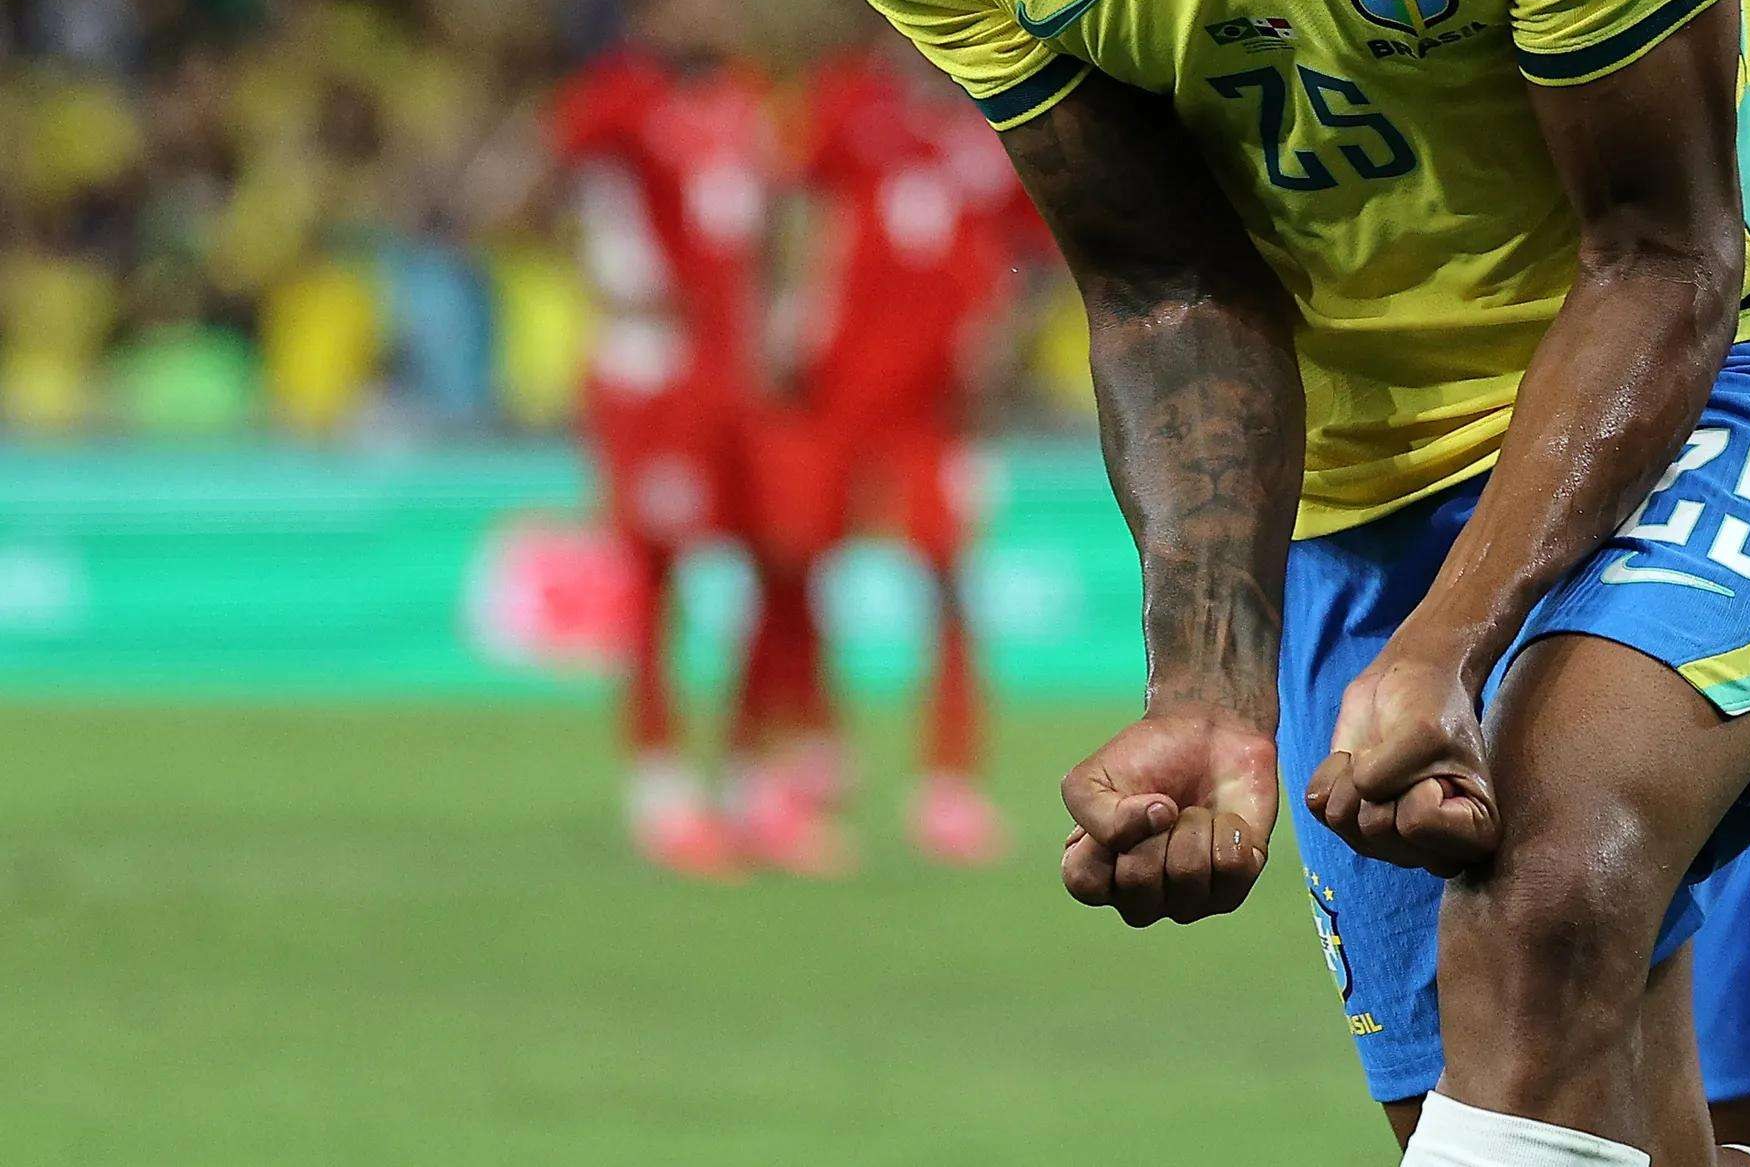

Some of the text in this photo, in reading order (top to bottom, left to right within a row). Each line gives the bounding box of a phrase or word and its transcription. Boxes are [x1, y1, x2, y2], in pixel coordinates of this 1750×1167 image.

[1366, 21, 1487, 59] BRASIL
[1204, 64, 1418, 191] 25
[1347, 1012, 1383, 1036] SIL
